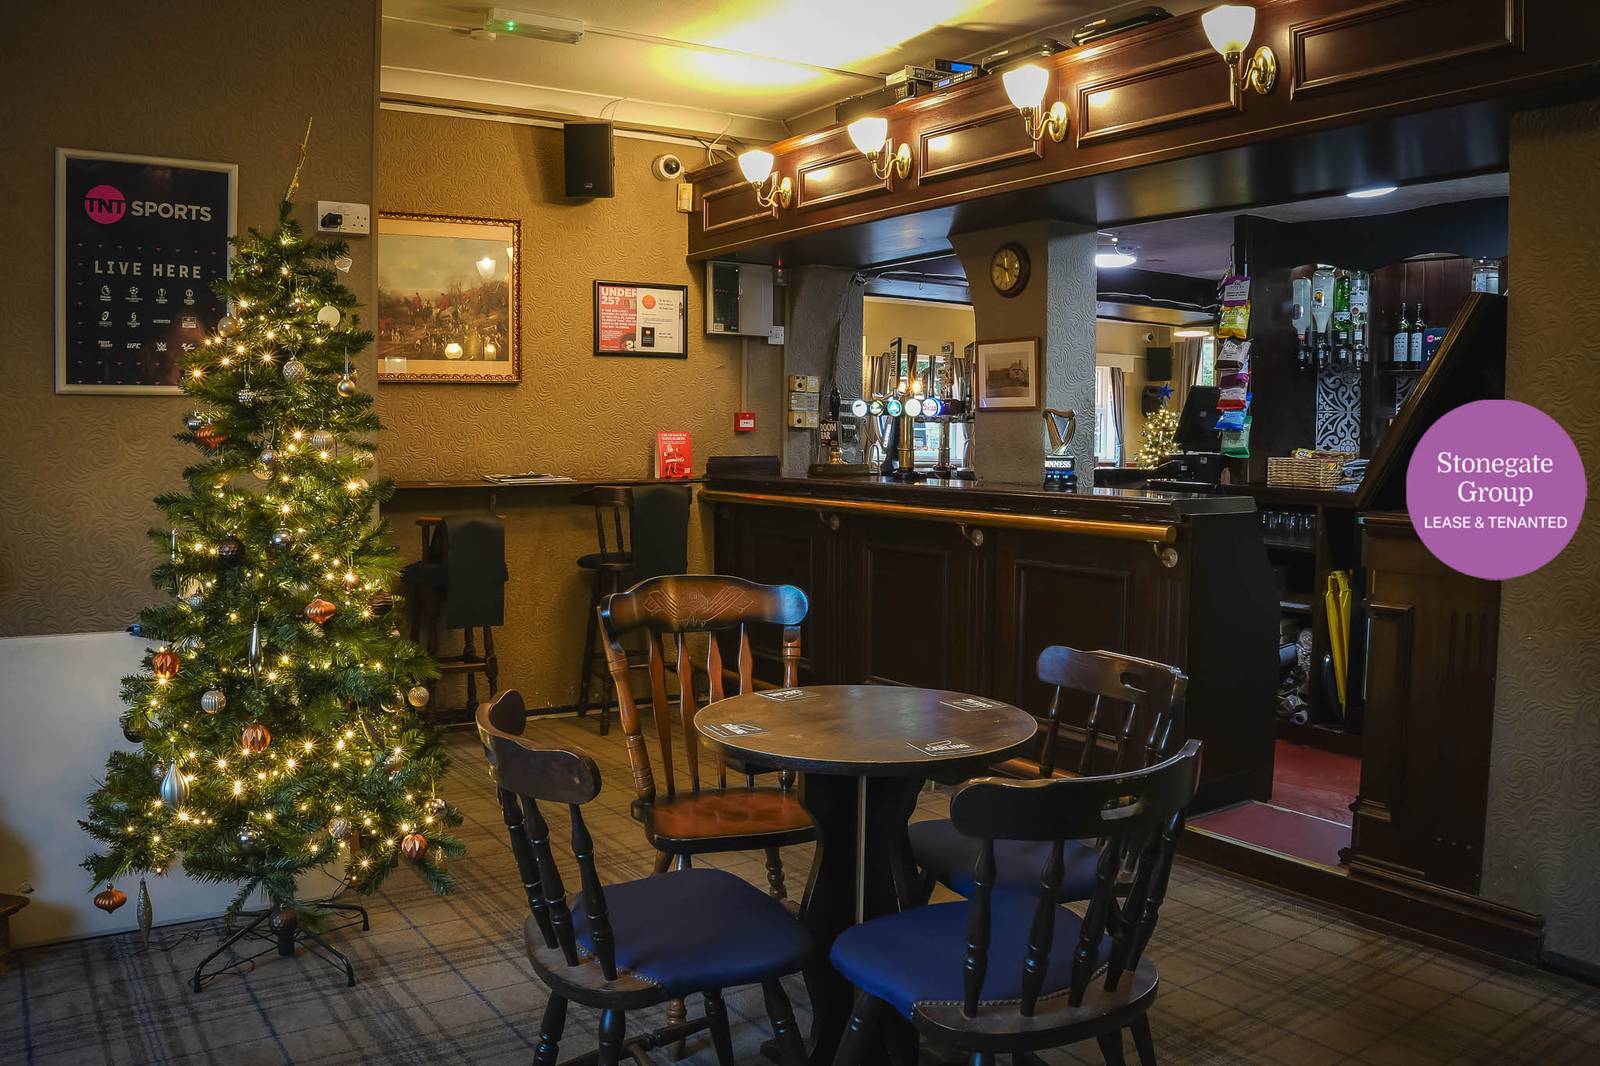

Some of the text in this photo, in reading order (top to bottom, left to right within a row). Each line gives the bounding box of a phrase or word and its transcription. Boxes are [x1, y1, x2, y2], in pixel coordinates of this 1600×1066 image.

[84, 197, 212, 222] TNT SPORTS
[94, 259, 202, 279] LIVE HERE
[601, 296, 620, 305] 25?
